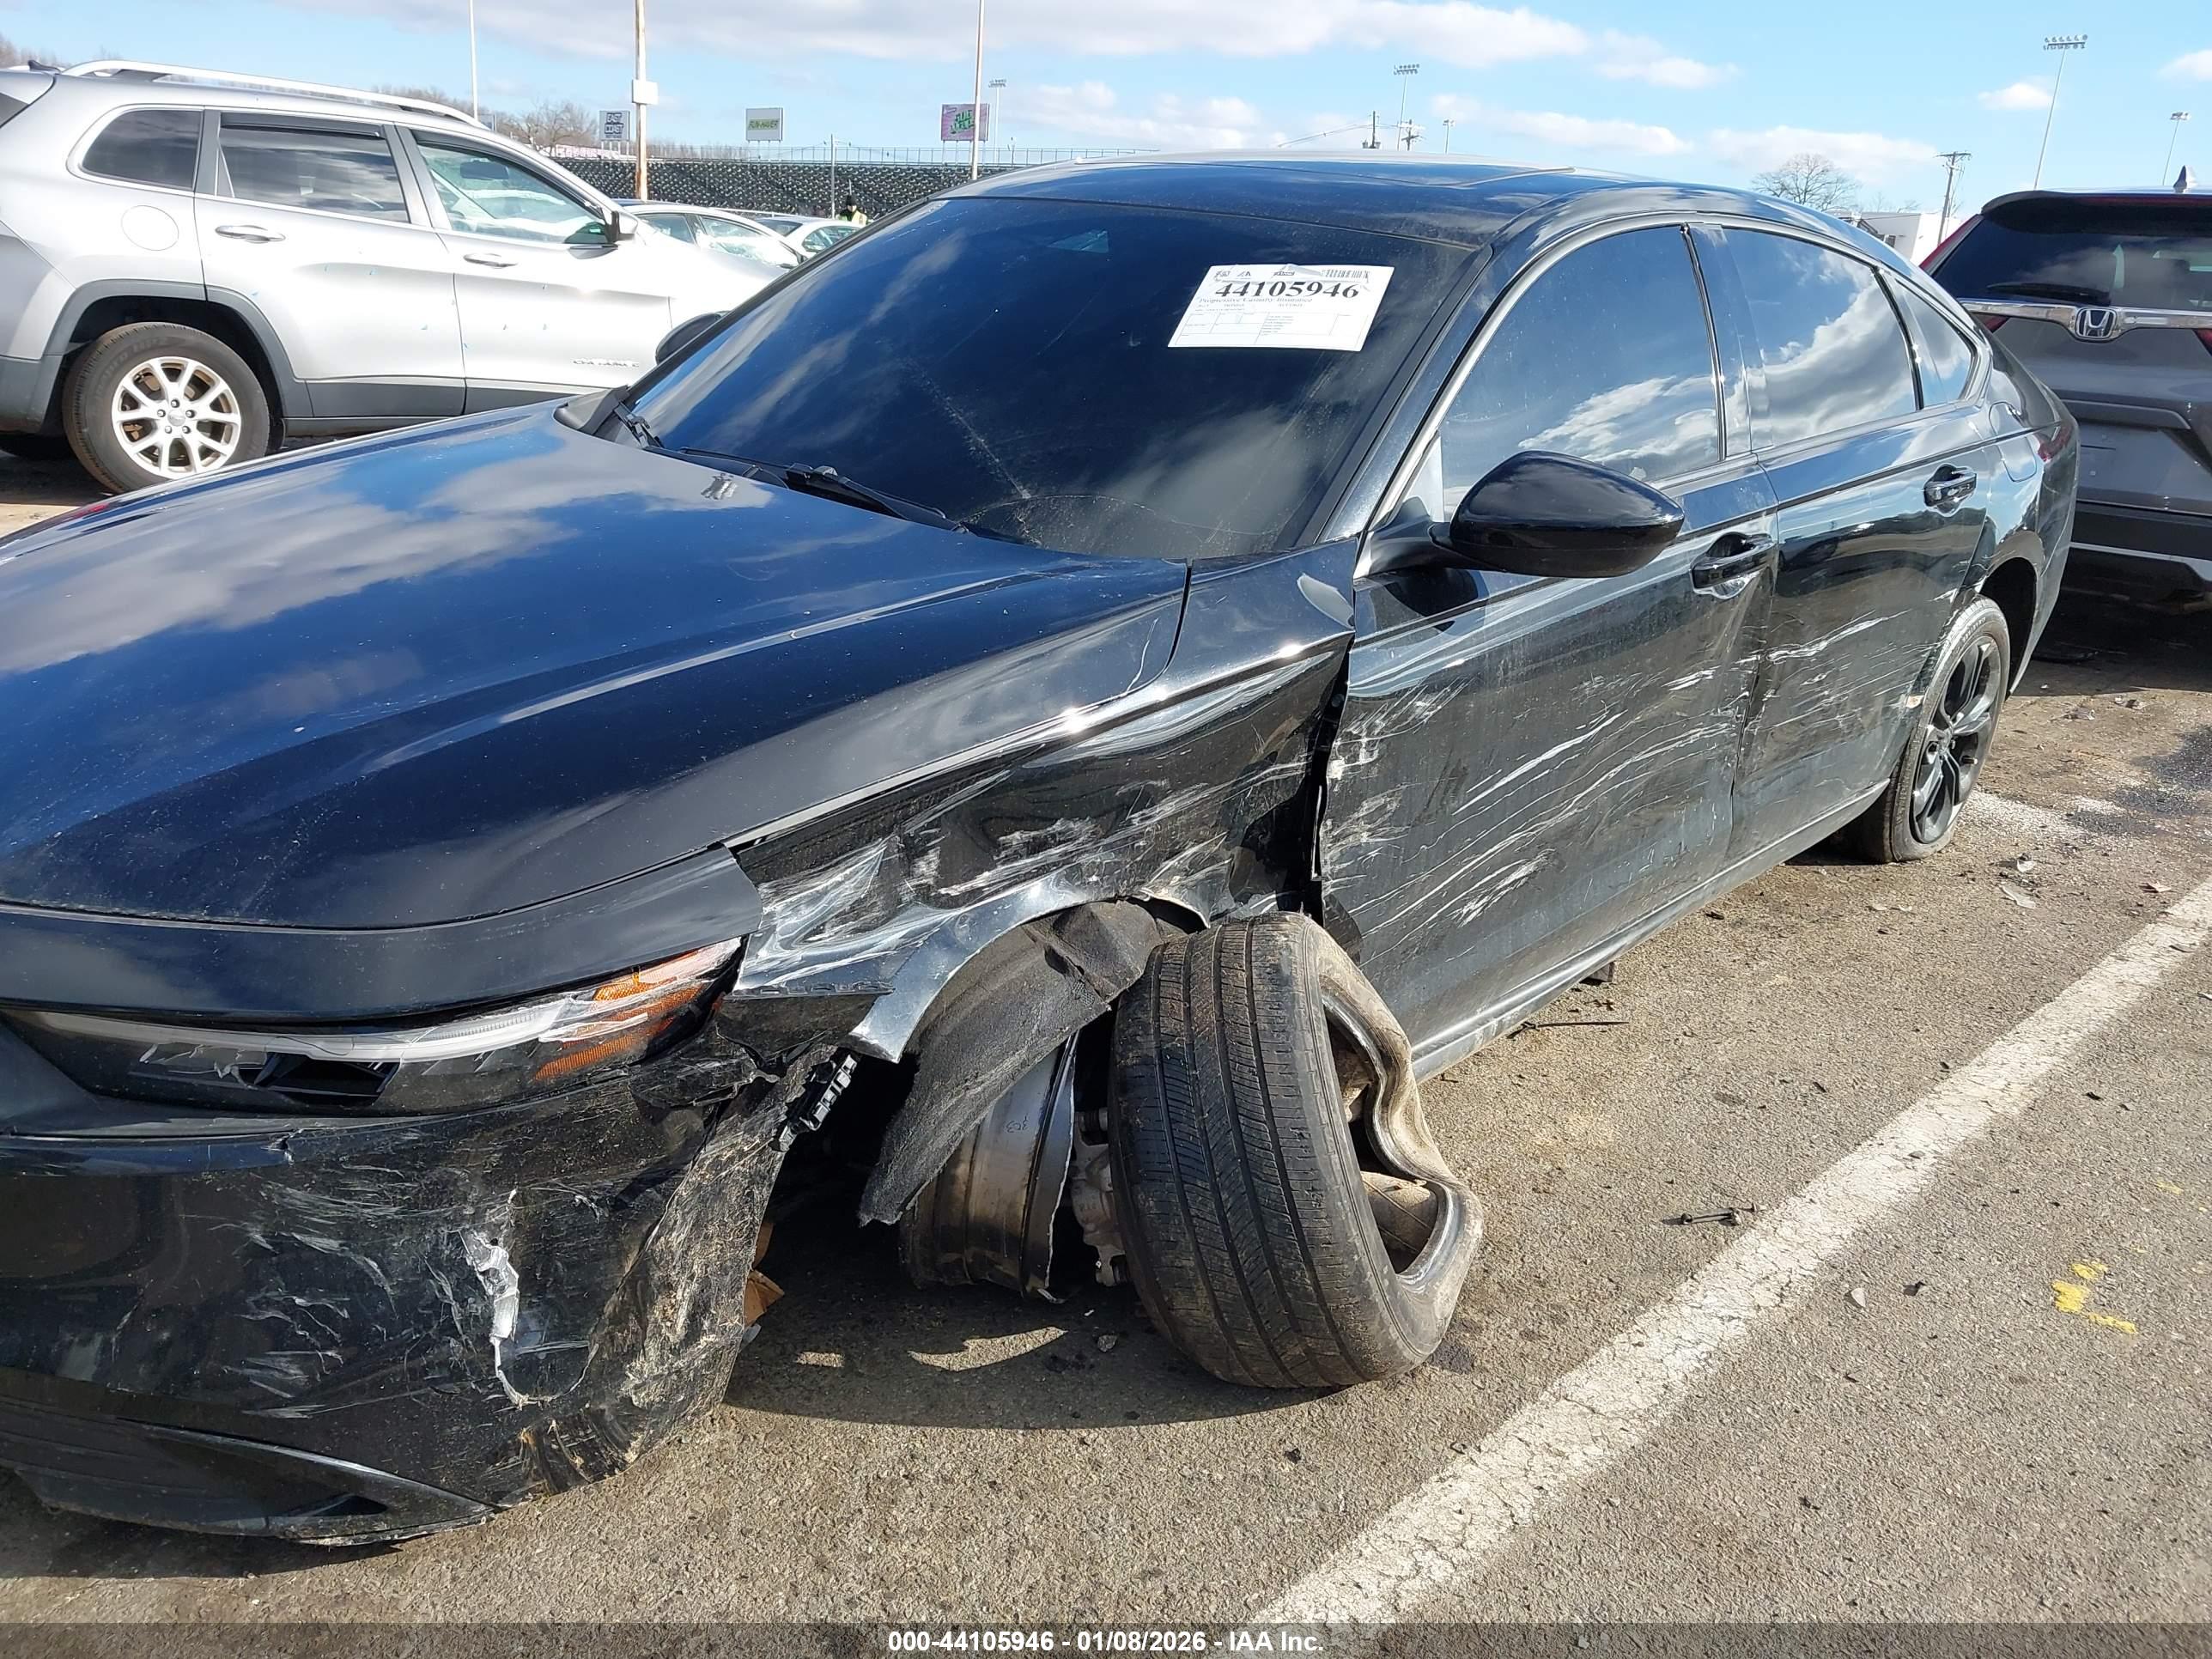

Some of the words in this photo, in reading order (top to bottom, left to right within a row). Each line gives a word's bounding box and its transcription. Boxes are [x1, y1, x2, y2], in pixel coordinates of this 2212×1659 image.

[606, 112, 623, 123] EAST
[605, 124, 624, 134] COAST
[1215, 281, 1359, 298] 44105946
